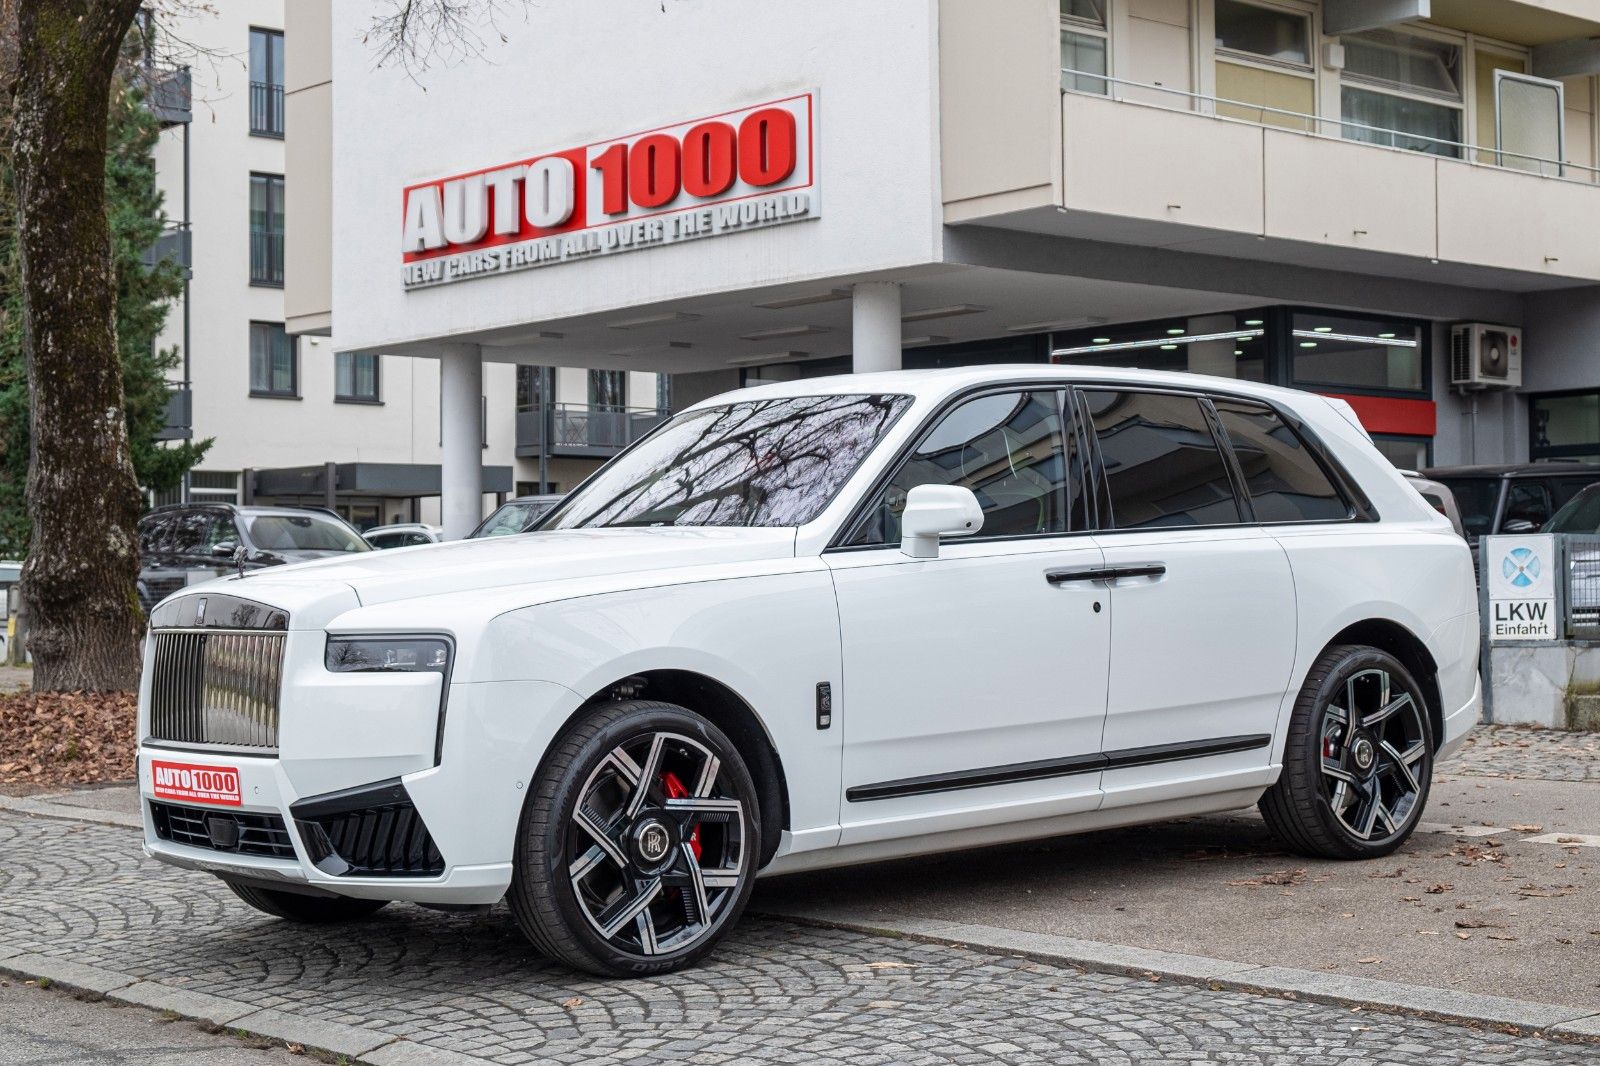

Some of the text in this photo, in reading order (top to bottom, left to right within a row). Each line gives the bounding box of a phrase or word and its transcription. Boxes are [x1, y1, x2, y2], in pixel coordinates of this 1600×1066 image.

[402, 107, 797, 253] AUTO 1000
[402, 194, 810, 286] NEW CARS FROM ALL OVER THE WORLD
[1495, 602, 1548, 621] LKW
[1496, 623, 1548, 636] Einfahrt
[155, 766, 236, 792] AUTO 1000
